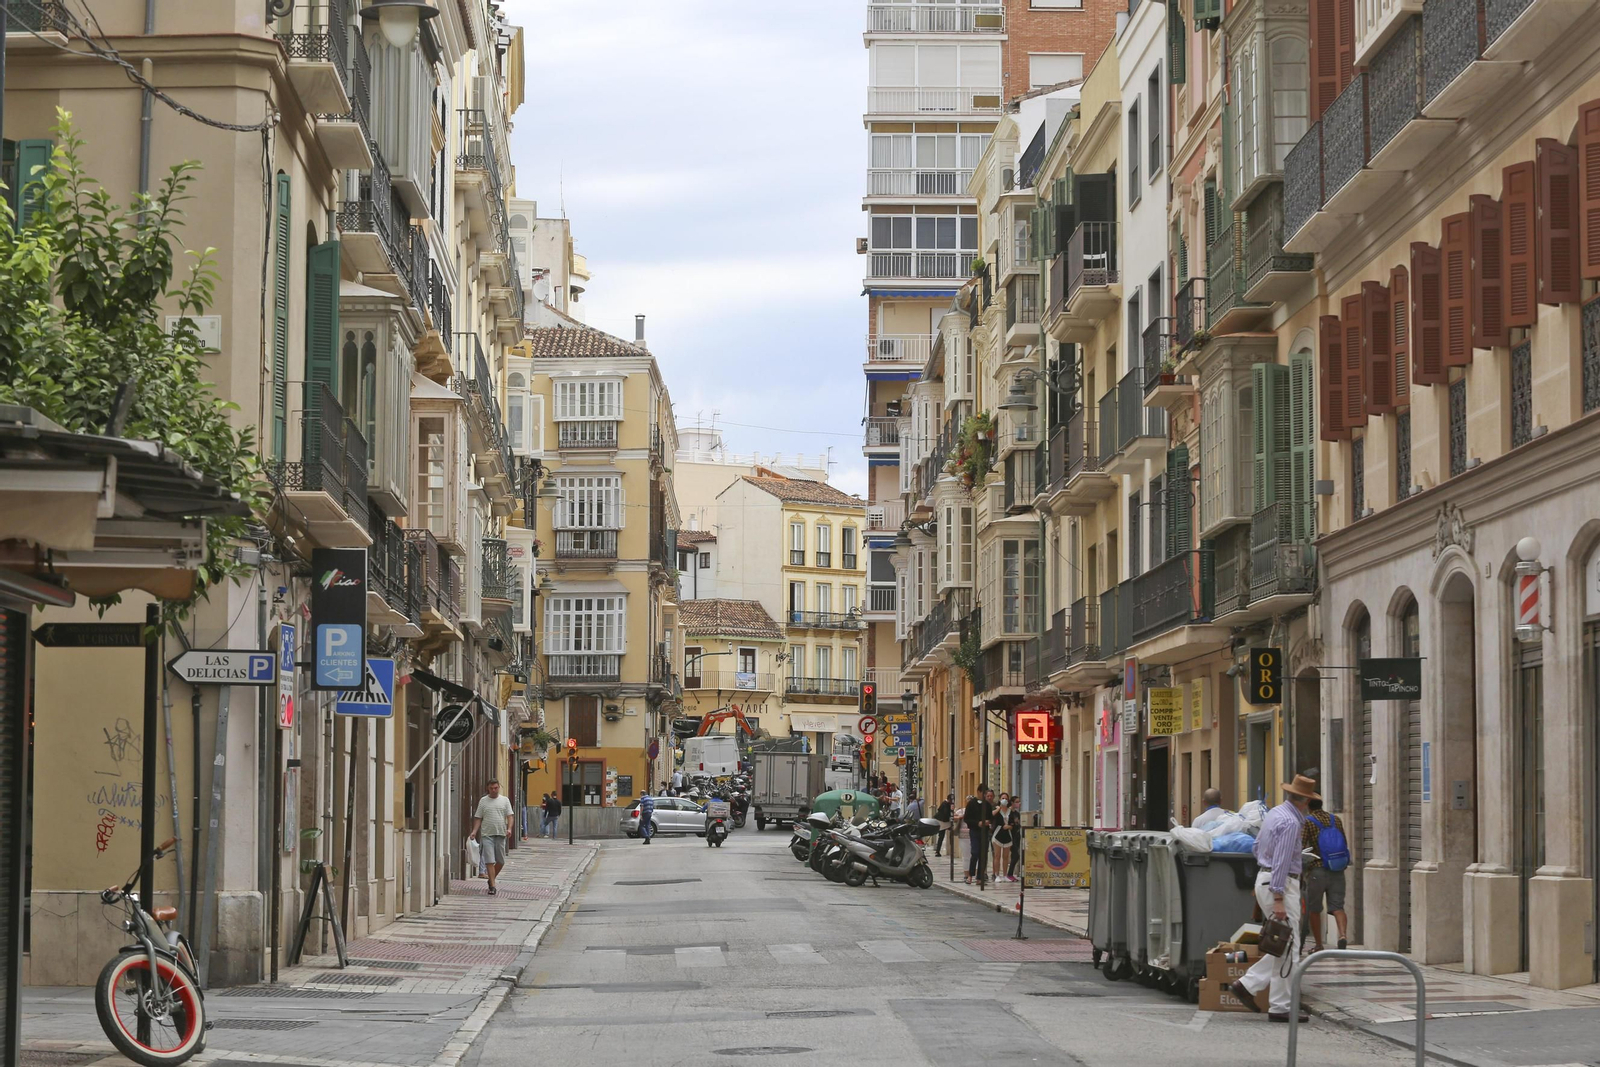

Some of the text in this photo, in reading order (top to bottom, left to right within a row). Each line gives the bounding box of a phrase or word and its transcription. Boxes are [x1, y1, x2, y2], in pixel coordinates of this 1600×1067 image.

[91, 634, 137, 645] CRISTINA
[205, 655, 230, 666] LAS
[187, 667, 247, 679] DELICIAS
[1258, 652, 1274, 699] ORO
[725, 702, 769, 714] NZARET
